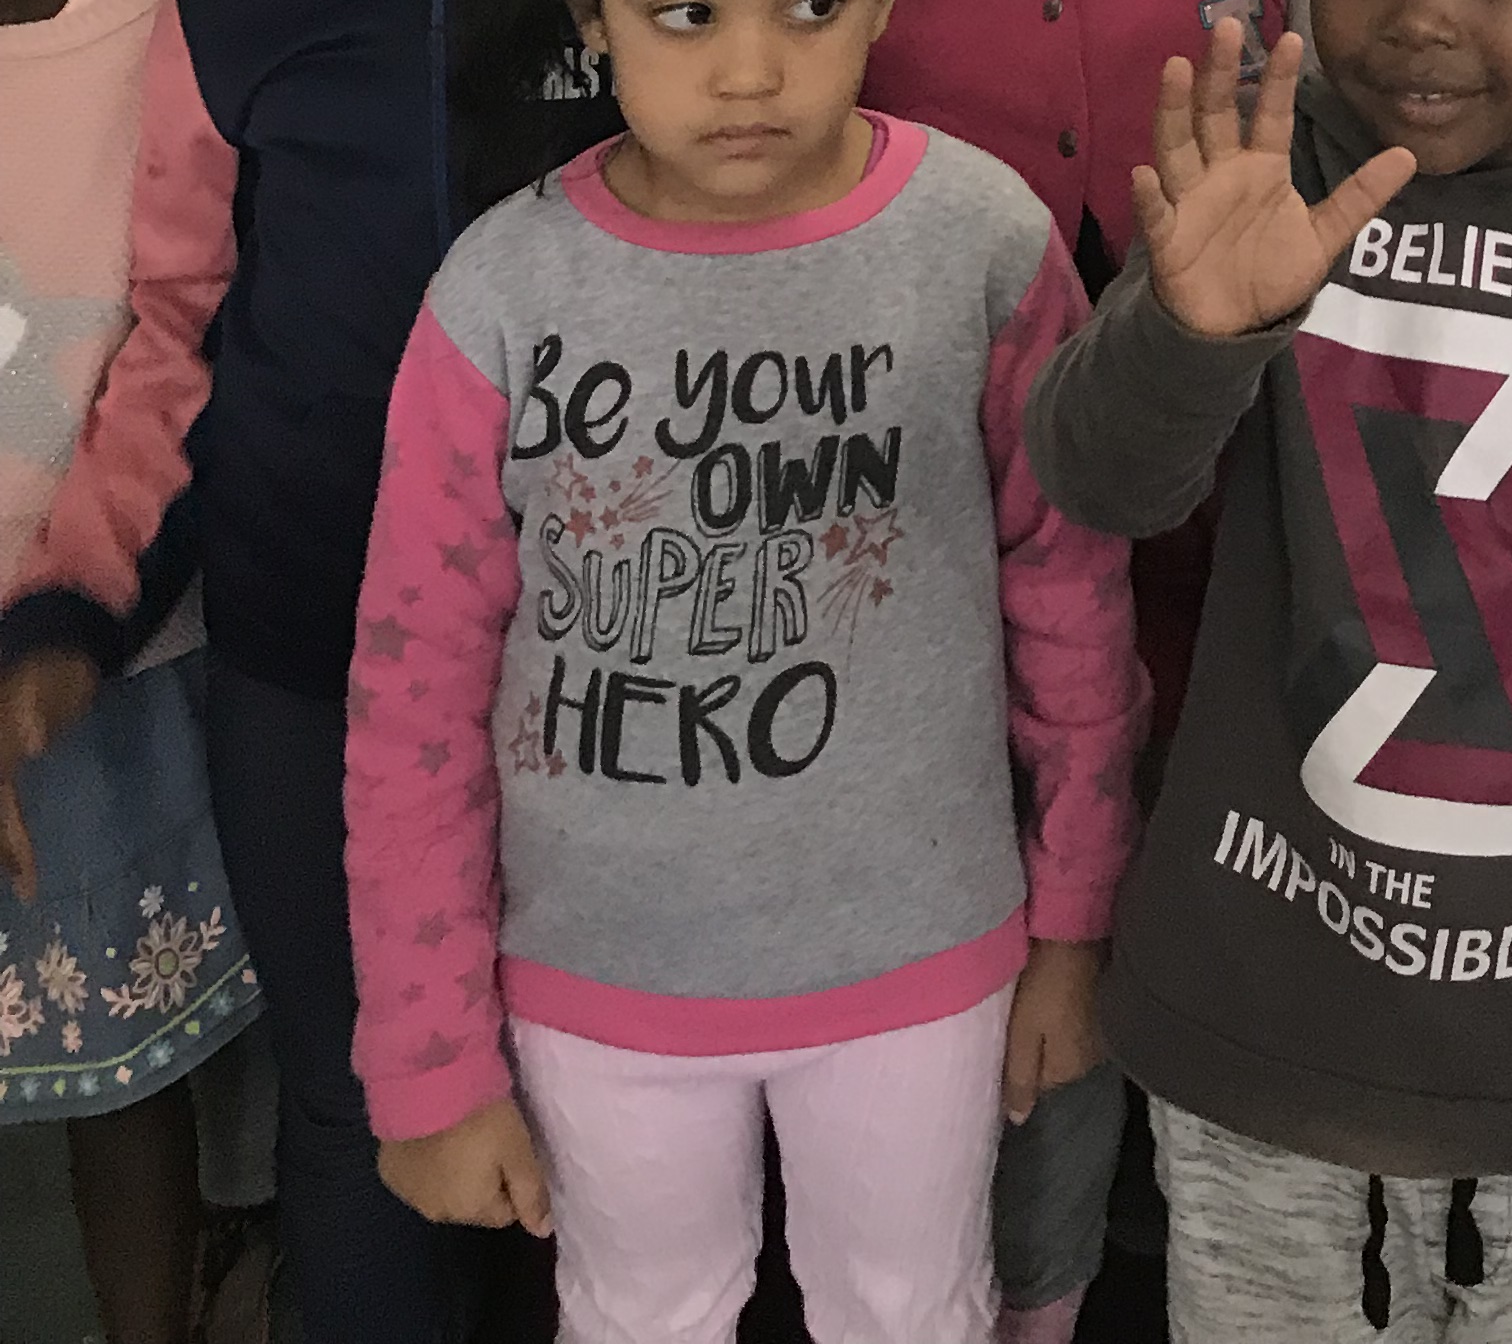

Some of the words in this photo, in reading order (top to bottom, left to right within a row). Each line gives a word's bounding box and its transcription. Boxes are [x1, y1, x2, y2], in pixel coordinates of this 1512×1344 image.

[511, 334, 632, 459] Be
[655, 343, 893, 459] your
[691, 426, 902, 538] OWN
[537, 513, 814, 664] SUPER
[542, 655, 838, 787] HERO
[1328, 837, 1356, 879] IN
[1365, 860, 1435, 910] THE
